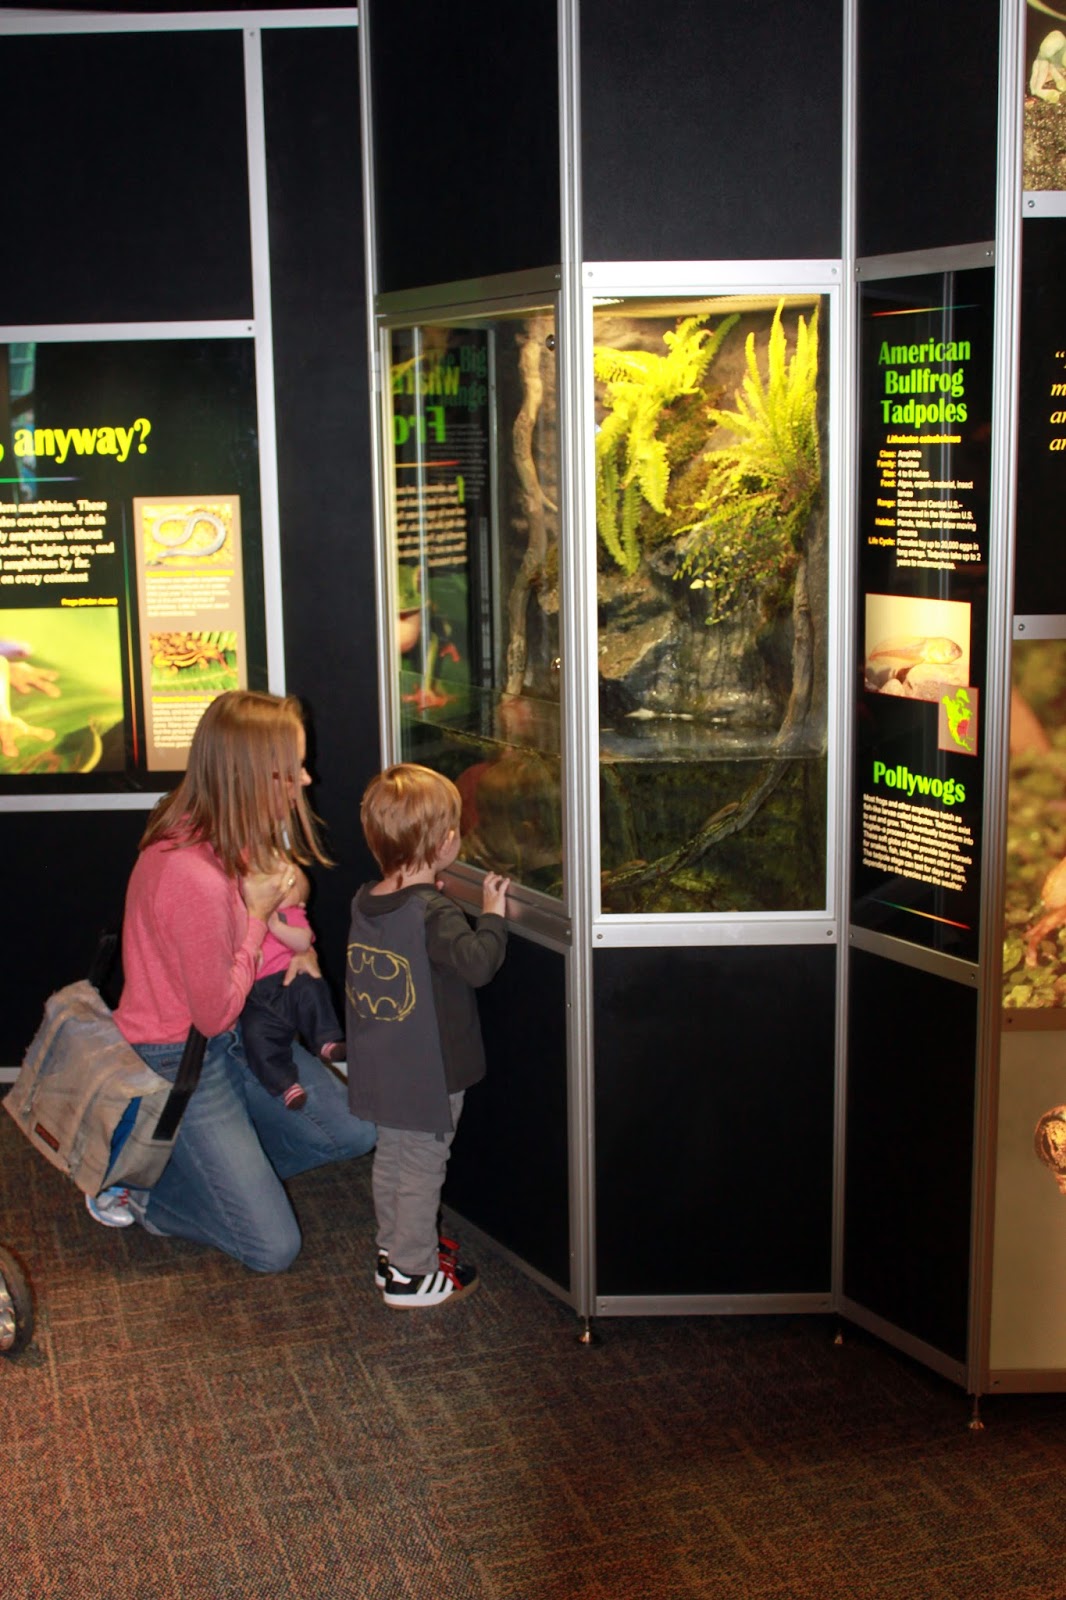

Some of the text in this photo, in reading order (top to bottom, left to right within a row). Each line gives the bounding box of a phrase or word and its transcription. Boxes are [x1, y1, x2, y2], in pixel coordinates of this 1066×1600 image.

[879, 338, 971, 365] American
[885, 368, 965, 398] Bullfrog
[880, 398, 968, 429] Tadpoles
[13, 417, 152, 465] anyway?
[898, 450, 922, 459] Amphibia
[902, 470, 907, 478] to
[913, 470, 929, 478] inches
[915, 480, 933, 489] organic
[957, 481, 973, 489] insect
[18, 500, 76, 515] amphibians.
[898, 499, 917, 507] Eastern
[918, 500, 927, 508] and
[928, 500, 947, 509] Central
[17, 515, 59, 528] covering
[61, 514, 83, 526] their
[85, 514, 105, 525] skin
[898, 509, 973, 520] introduced in the Western U.S.
[897, 519, 915, 528] Ponds,
[916, 519, 931, 529] lakes,
[932, 520, 942, 529] and
[943, 521, 955, 529] slow
[957, 522, 976, 531] moving
[9, 529, 64, 544] amphibians
[66, 528, 102, 540] without
[31, 543, 68, 558] bulging
[69, 545, 94, 556] eyes,
[96, 542, 114, 553] and
[897, 538, 918, 547] Females
[927, 541, 934, 549] up
[959, 543, 972, 551] eggs
[897, 548, 908, 558] long
[927, 549, 949, 560] Tadpoles
[951, 552, 961, 560] take
[977, 553, 981, 561] 2
[4, 558, 58, 572] amphibians
[60, 557, 72, 571] by
[75, 557, 90, 568] far.
[897, 559, 910, 567] years
[911, 559, 916, 567] to
[15, 574, 42, 586] every
[873, 761, 966, 805] Pollywogs
[898, 802, 911, 811] other
[911, 806, 939, 818] amphibians
[940, 811, 954, 821] hatch
[897, 812, 911, 821] called
[935, 819, 957, 832] Tadpoles
[901, 820, 913, 832] They
[939, 830, 962, 842] transform
[964, 836, 973, 845] into
[906, 833, 920, 842] called
[902, 840, 906, 848] of
[863, 848, 872, 857] The
[932, 867, 943, 877] days
[924, 855, 936, 865] even
[937, 859, 950, 868] other
[951, 862, 965, 873] frogs.
[922, 875, 932, 883] and
